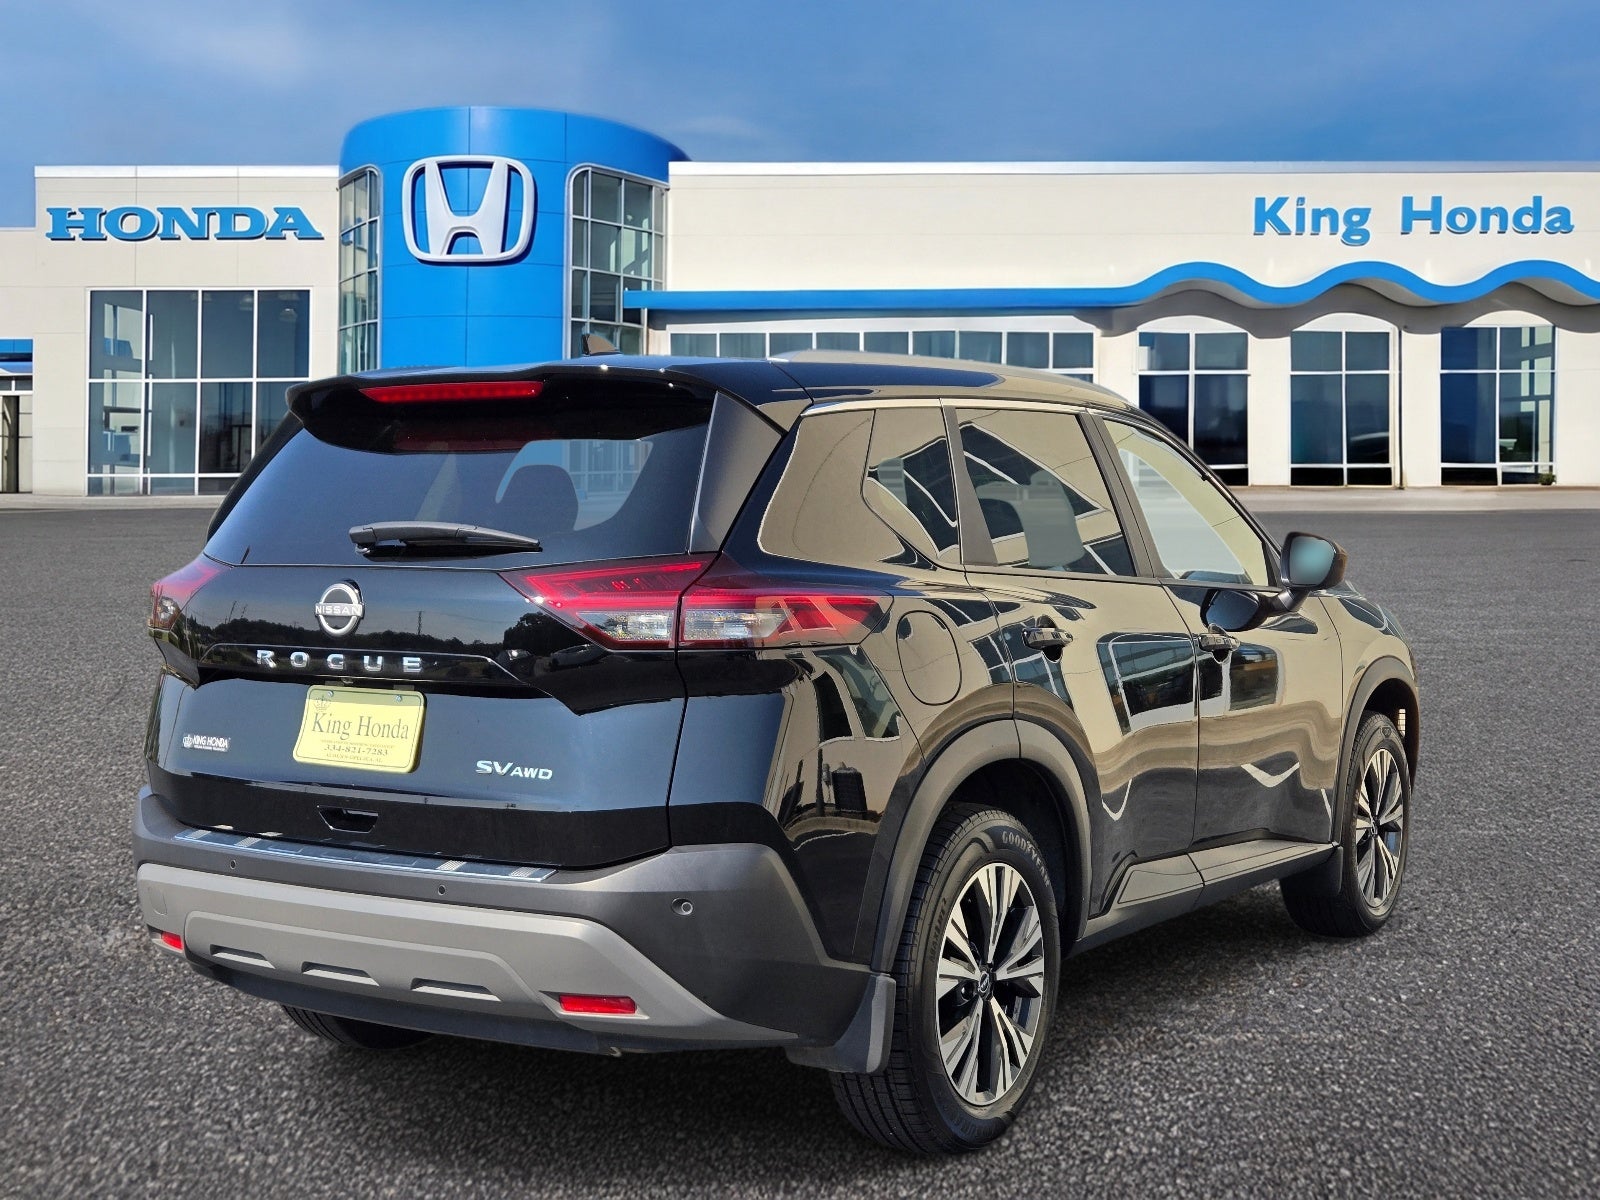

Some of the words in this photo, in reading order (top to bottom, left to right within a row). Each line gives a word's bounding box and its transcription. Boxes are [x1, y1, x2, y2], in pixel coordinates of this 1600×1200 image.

[45, 206, 324, 242] HONDA
[1253, 196, 1372, 246] King
[1400, 195, 1574, 236] Honda
[315, 605, 361, 615] NISSAN
[256, 649, 423, 673] ROGUE
[312, 712, 353, 740] King
[355, 716, 409, 739] Honda
[193, 734, 207, 745] KING
[207, 736, 228, 748] HONDA
[323, 744, 388, 756] 334-821-7283
[475, 760, 513, 776] SV
[510, 766, 553, 780] AWD
[1001, 830, 1051, 887] GOODYEAR
